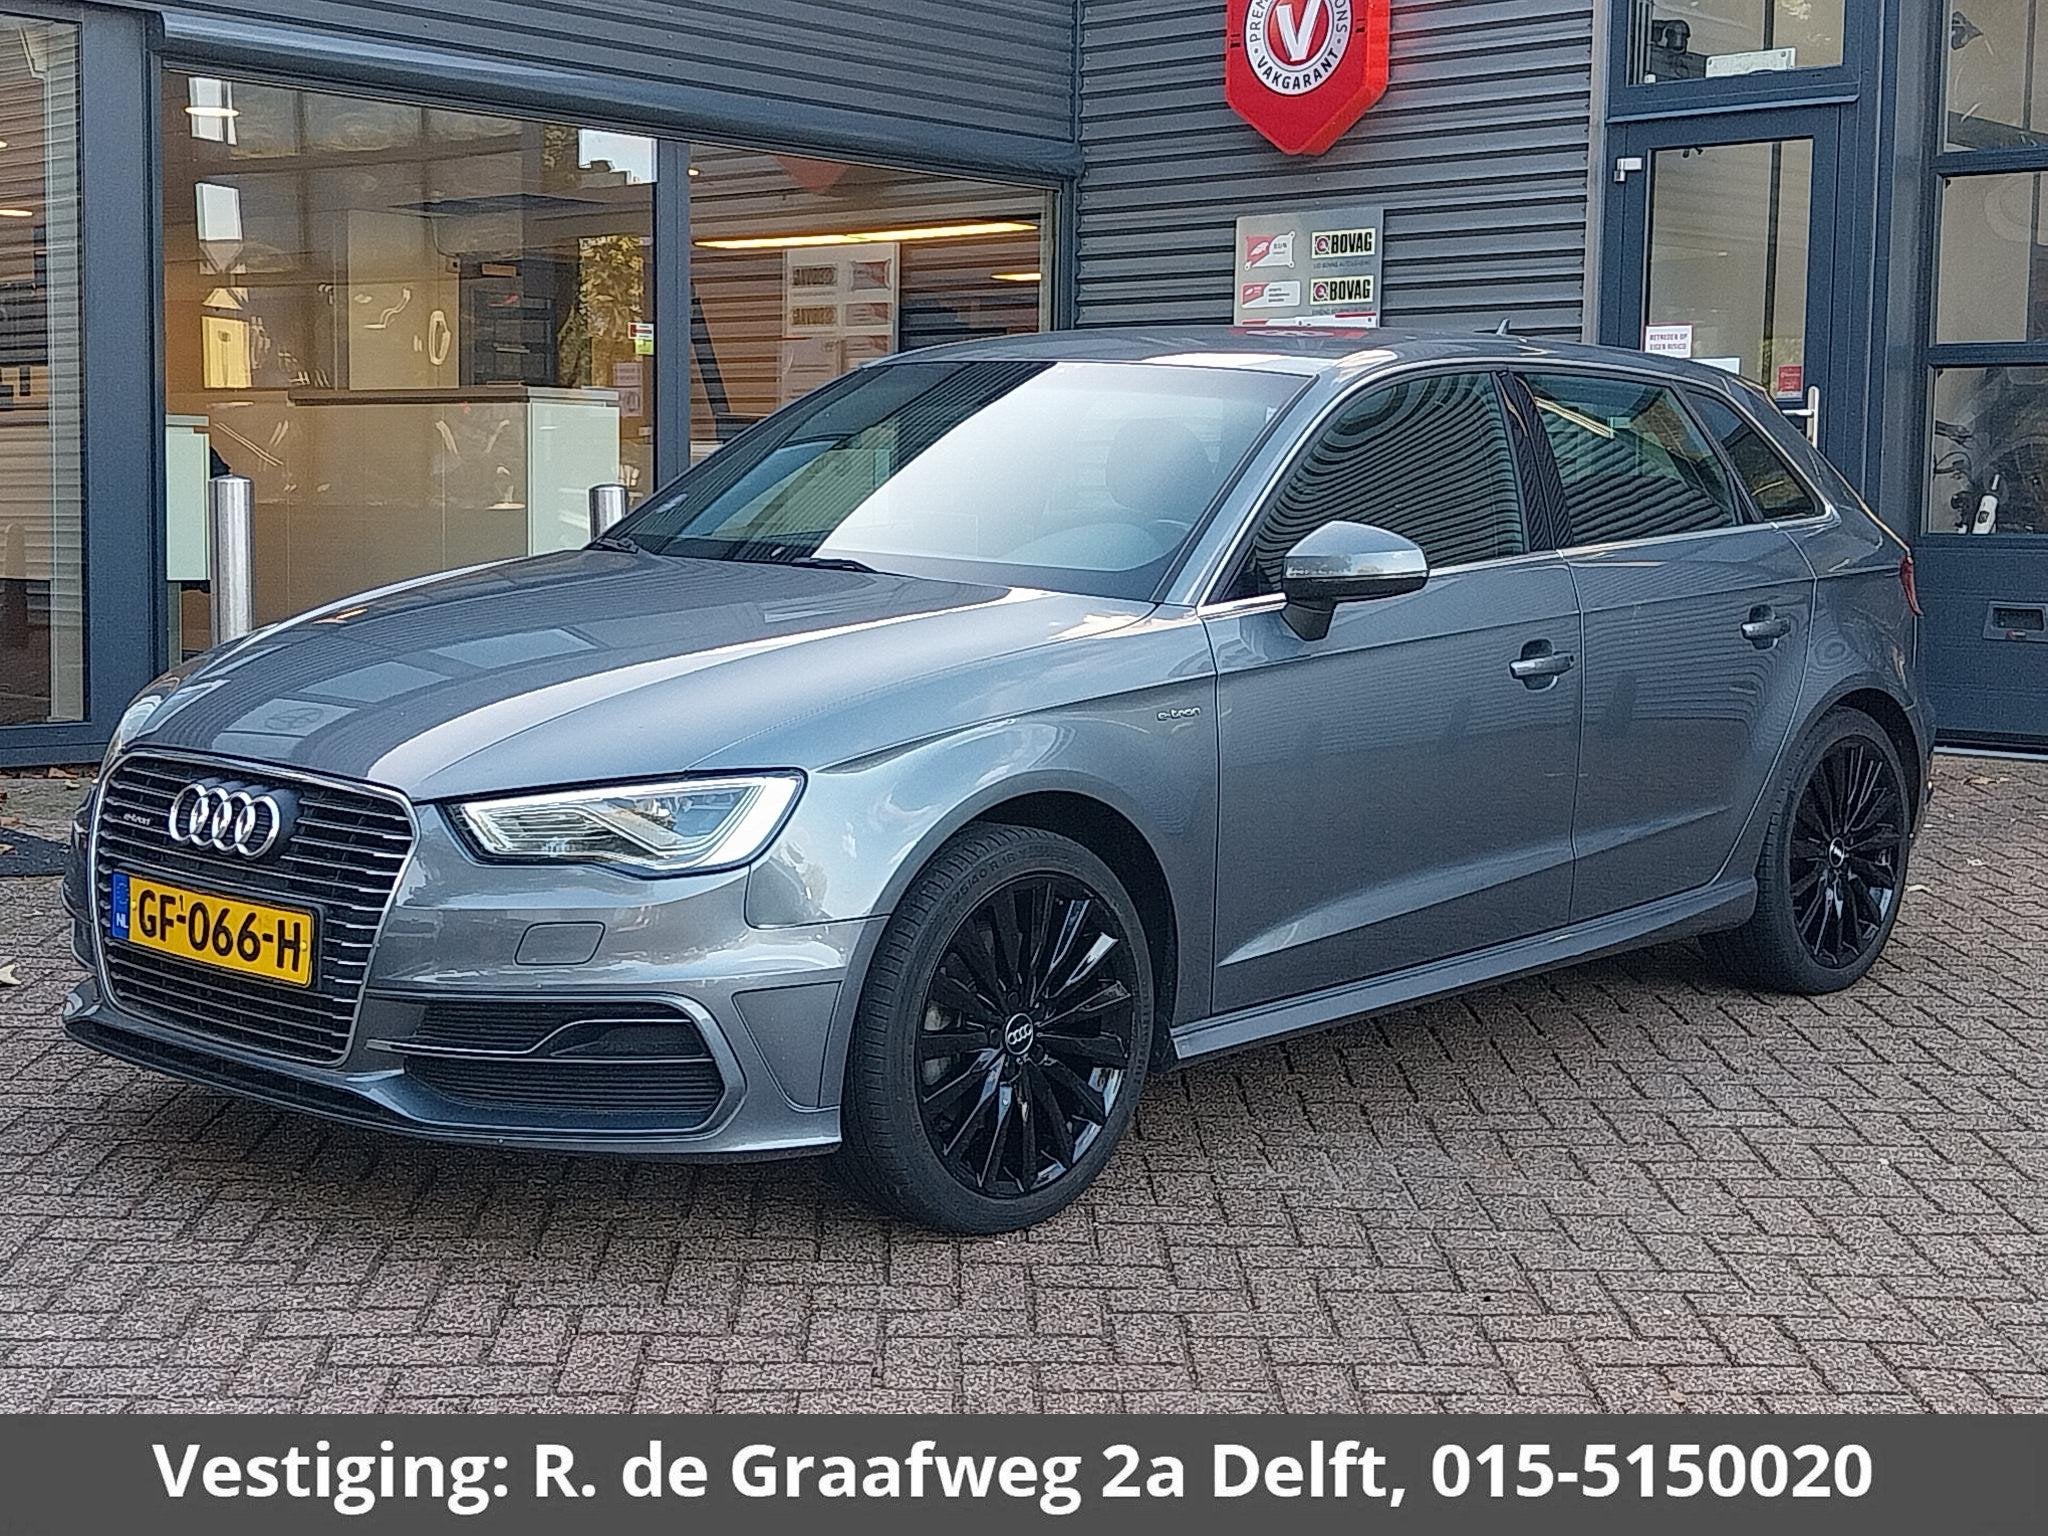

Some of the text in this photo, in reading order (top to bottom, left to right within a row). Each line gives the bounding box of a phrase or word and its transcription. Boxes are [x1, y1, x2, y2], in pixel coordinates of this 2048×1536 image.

[1257, 48, 1339, 90] VAKGARANT
[1331, 231, 1373, 254] BOVAG
[1329, 279, 1371, 301] BOVAG
[1157, 707, 1201, 720] e-tron
[116, 912, 129, 929] NL
[138, 889, 301, 973] GF-066-H
